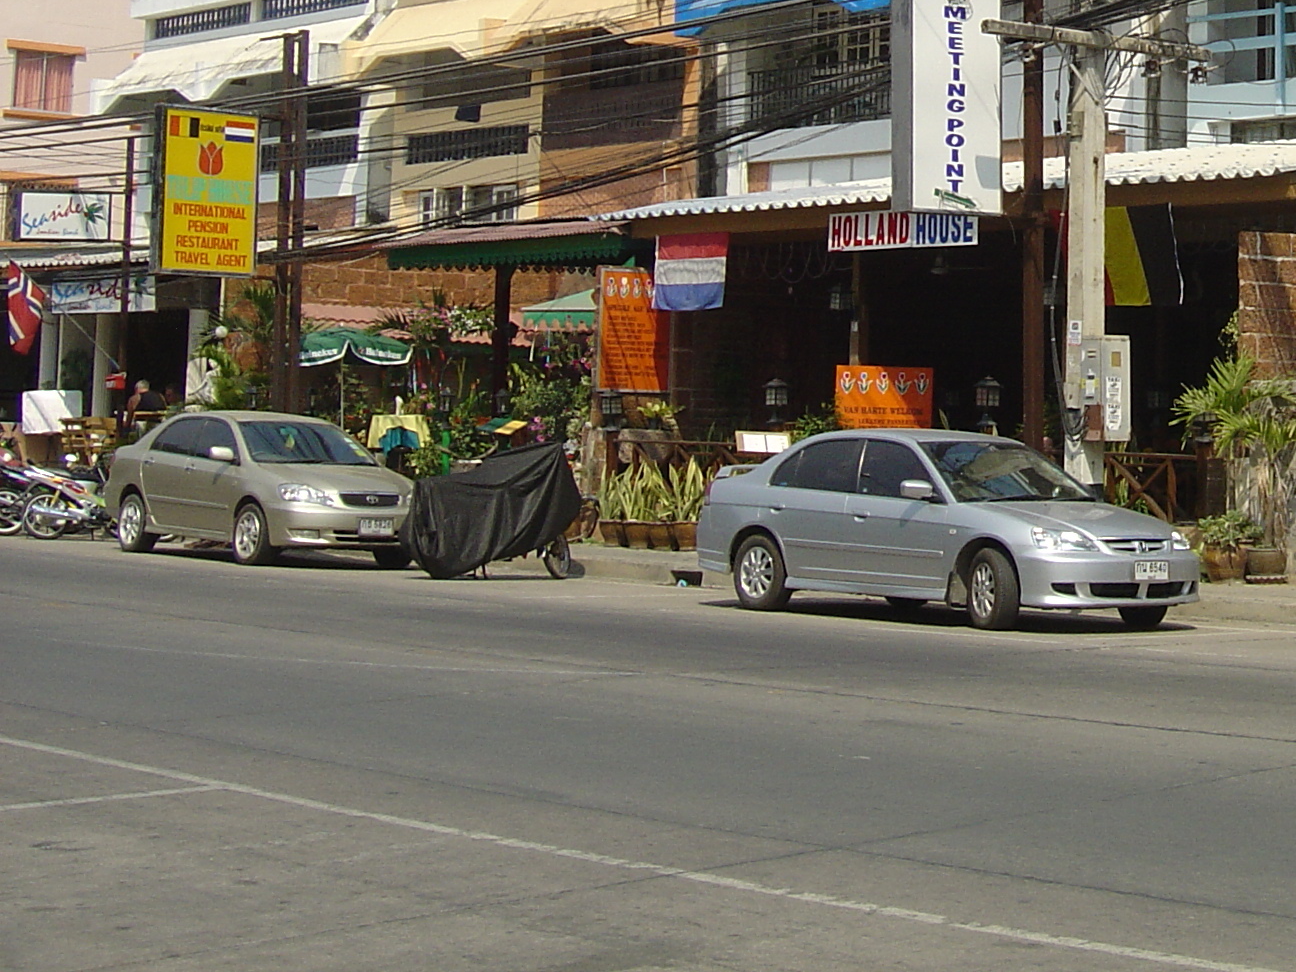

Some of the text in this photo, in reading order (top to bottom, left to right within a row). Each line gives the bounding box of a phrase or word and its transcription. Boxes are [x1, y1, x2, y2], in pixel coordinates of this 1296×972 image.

[944, 5, 967, 193] MEETING POINT
[22, 196, 84, 236] Seaside
[173, 202, 247, 220] INTERNATIONAL
[187, 219, 229, 234] PENSION
[831, 212, 974, 248] HOLLAND HOUSE
[176, 234, 240, 251] RESTAURANT
[174, 250, 248, 268] TRAVEL AGENT
[52, 275, 124, 302] Seasid
